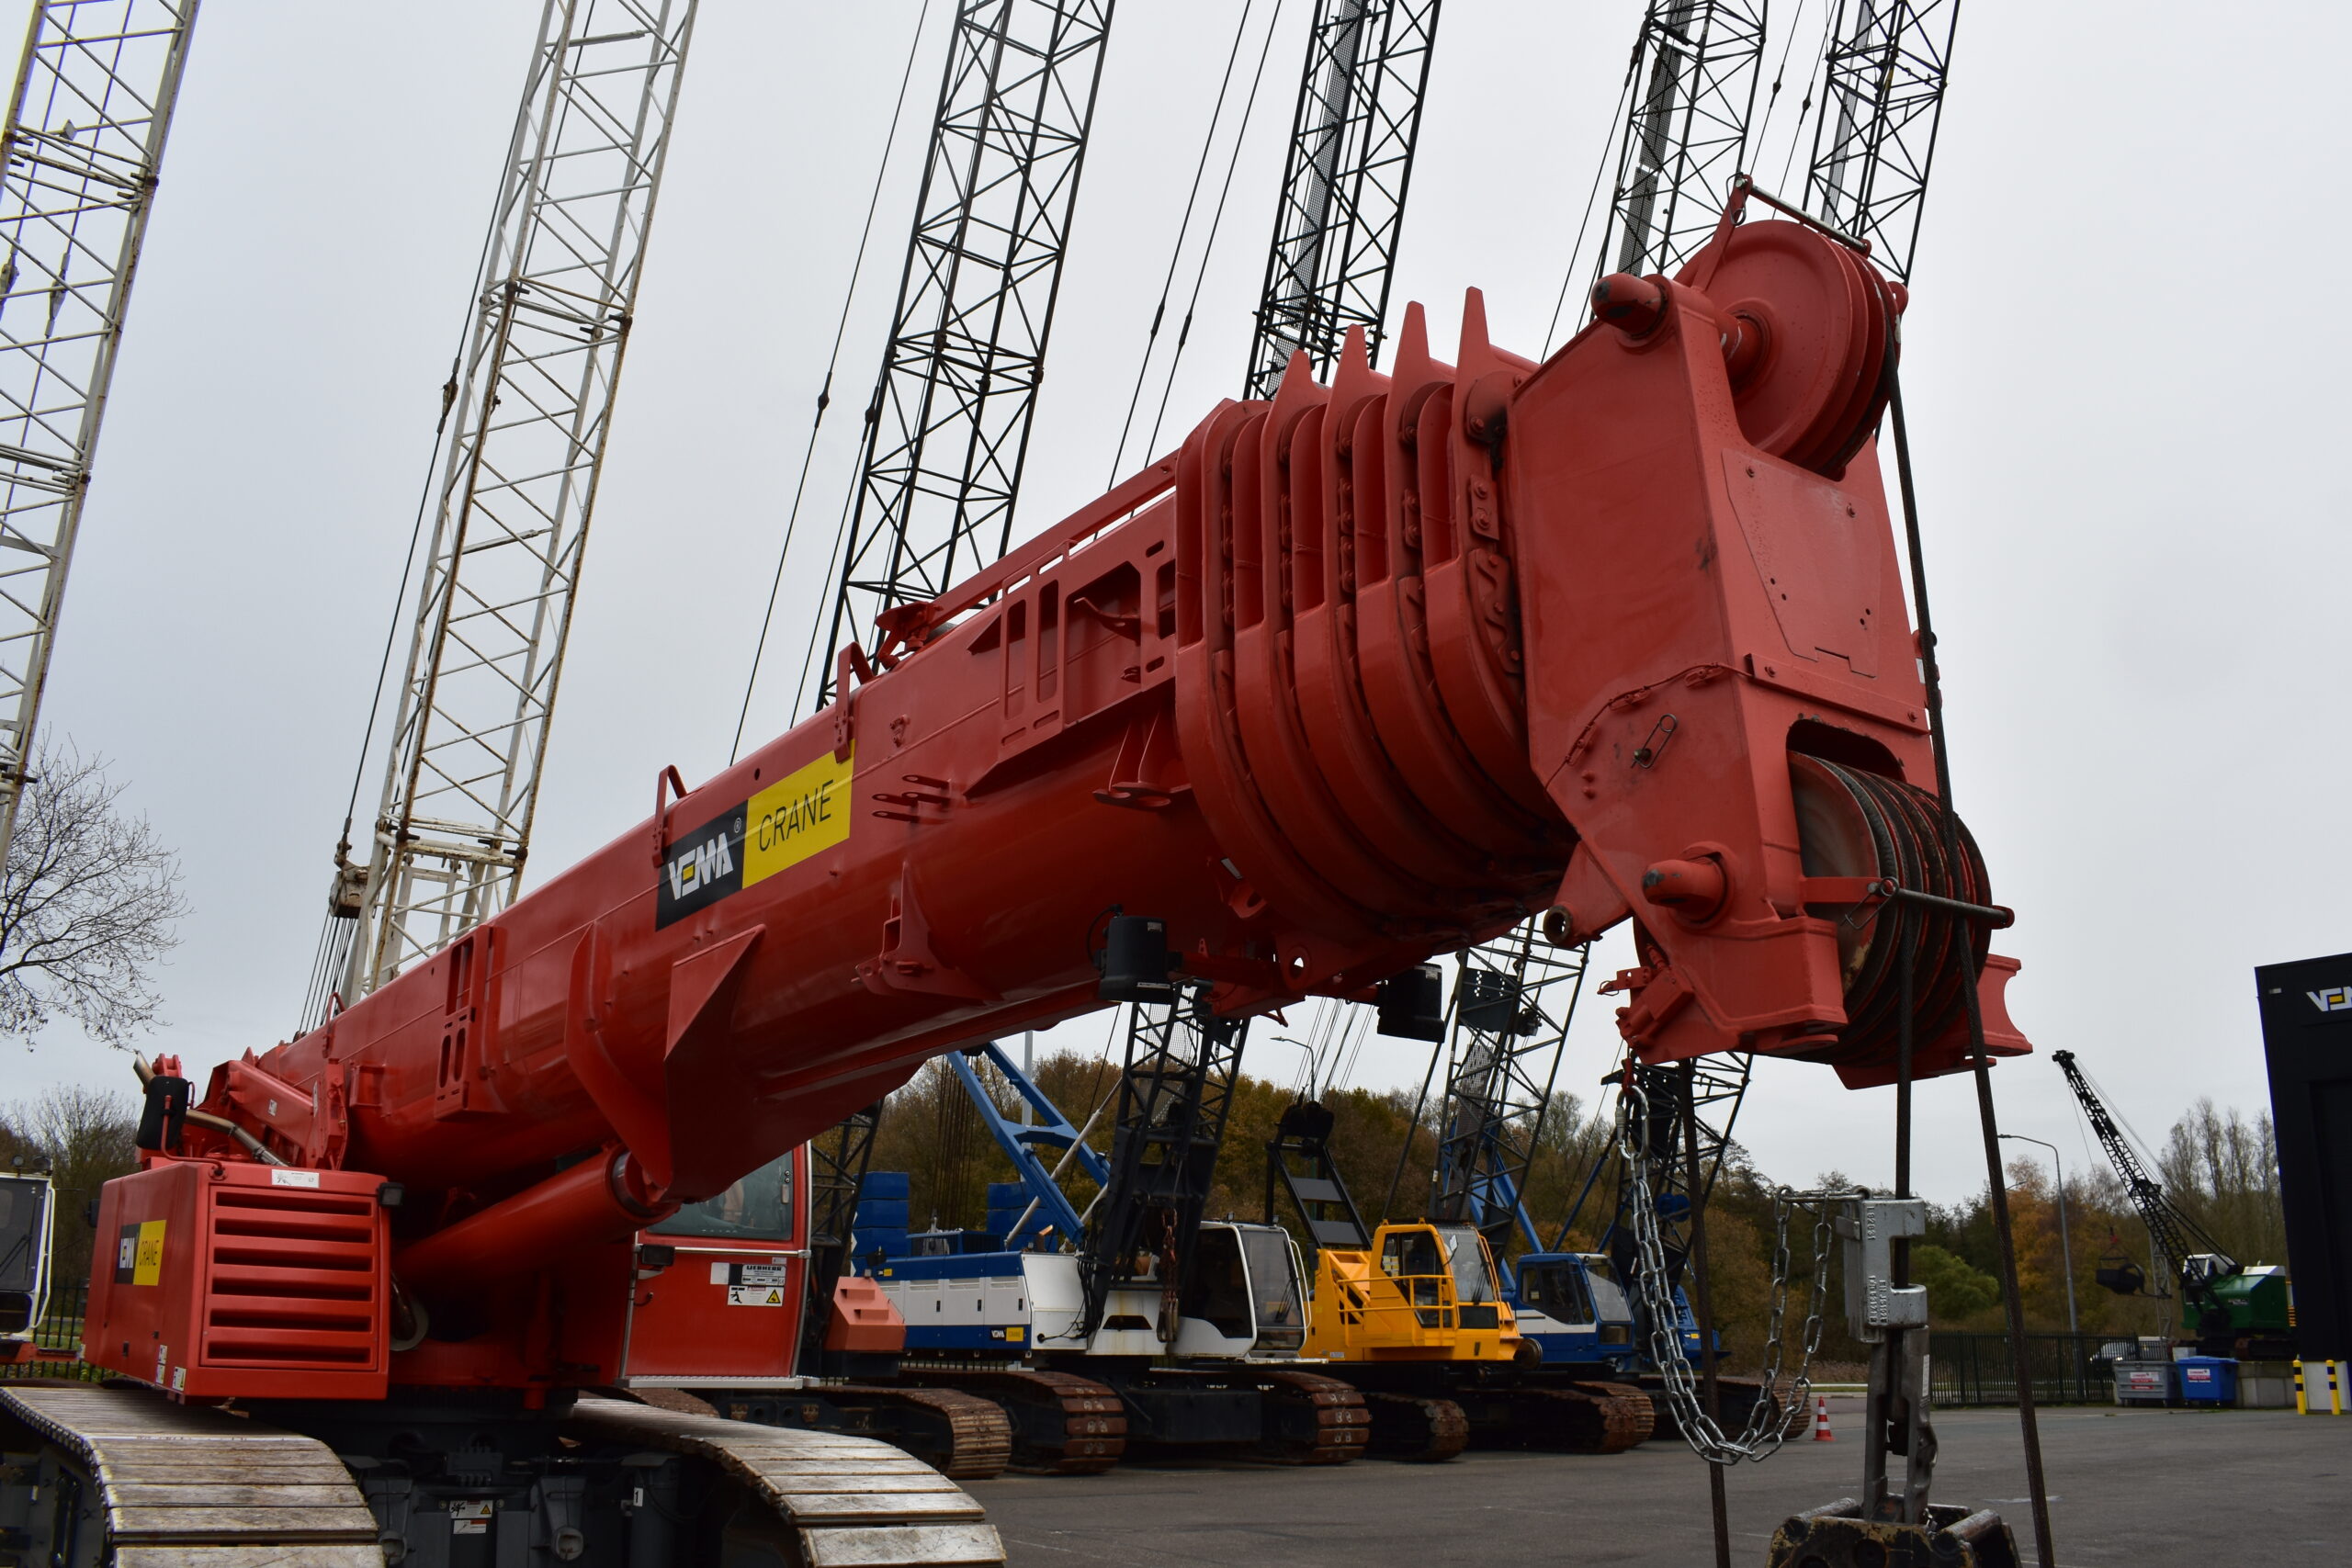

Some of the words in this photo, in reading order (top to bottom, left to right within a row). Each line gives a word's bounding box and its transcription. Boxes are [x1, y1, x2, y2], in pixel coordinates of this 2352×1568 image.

[668, 832, 734, 901] VEMA
[759, 779, 834, 852] CRANE
[634, 1490, 639, 1504] 1
